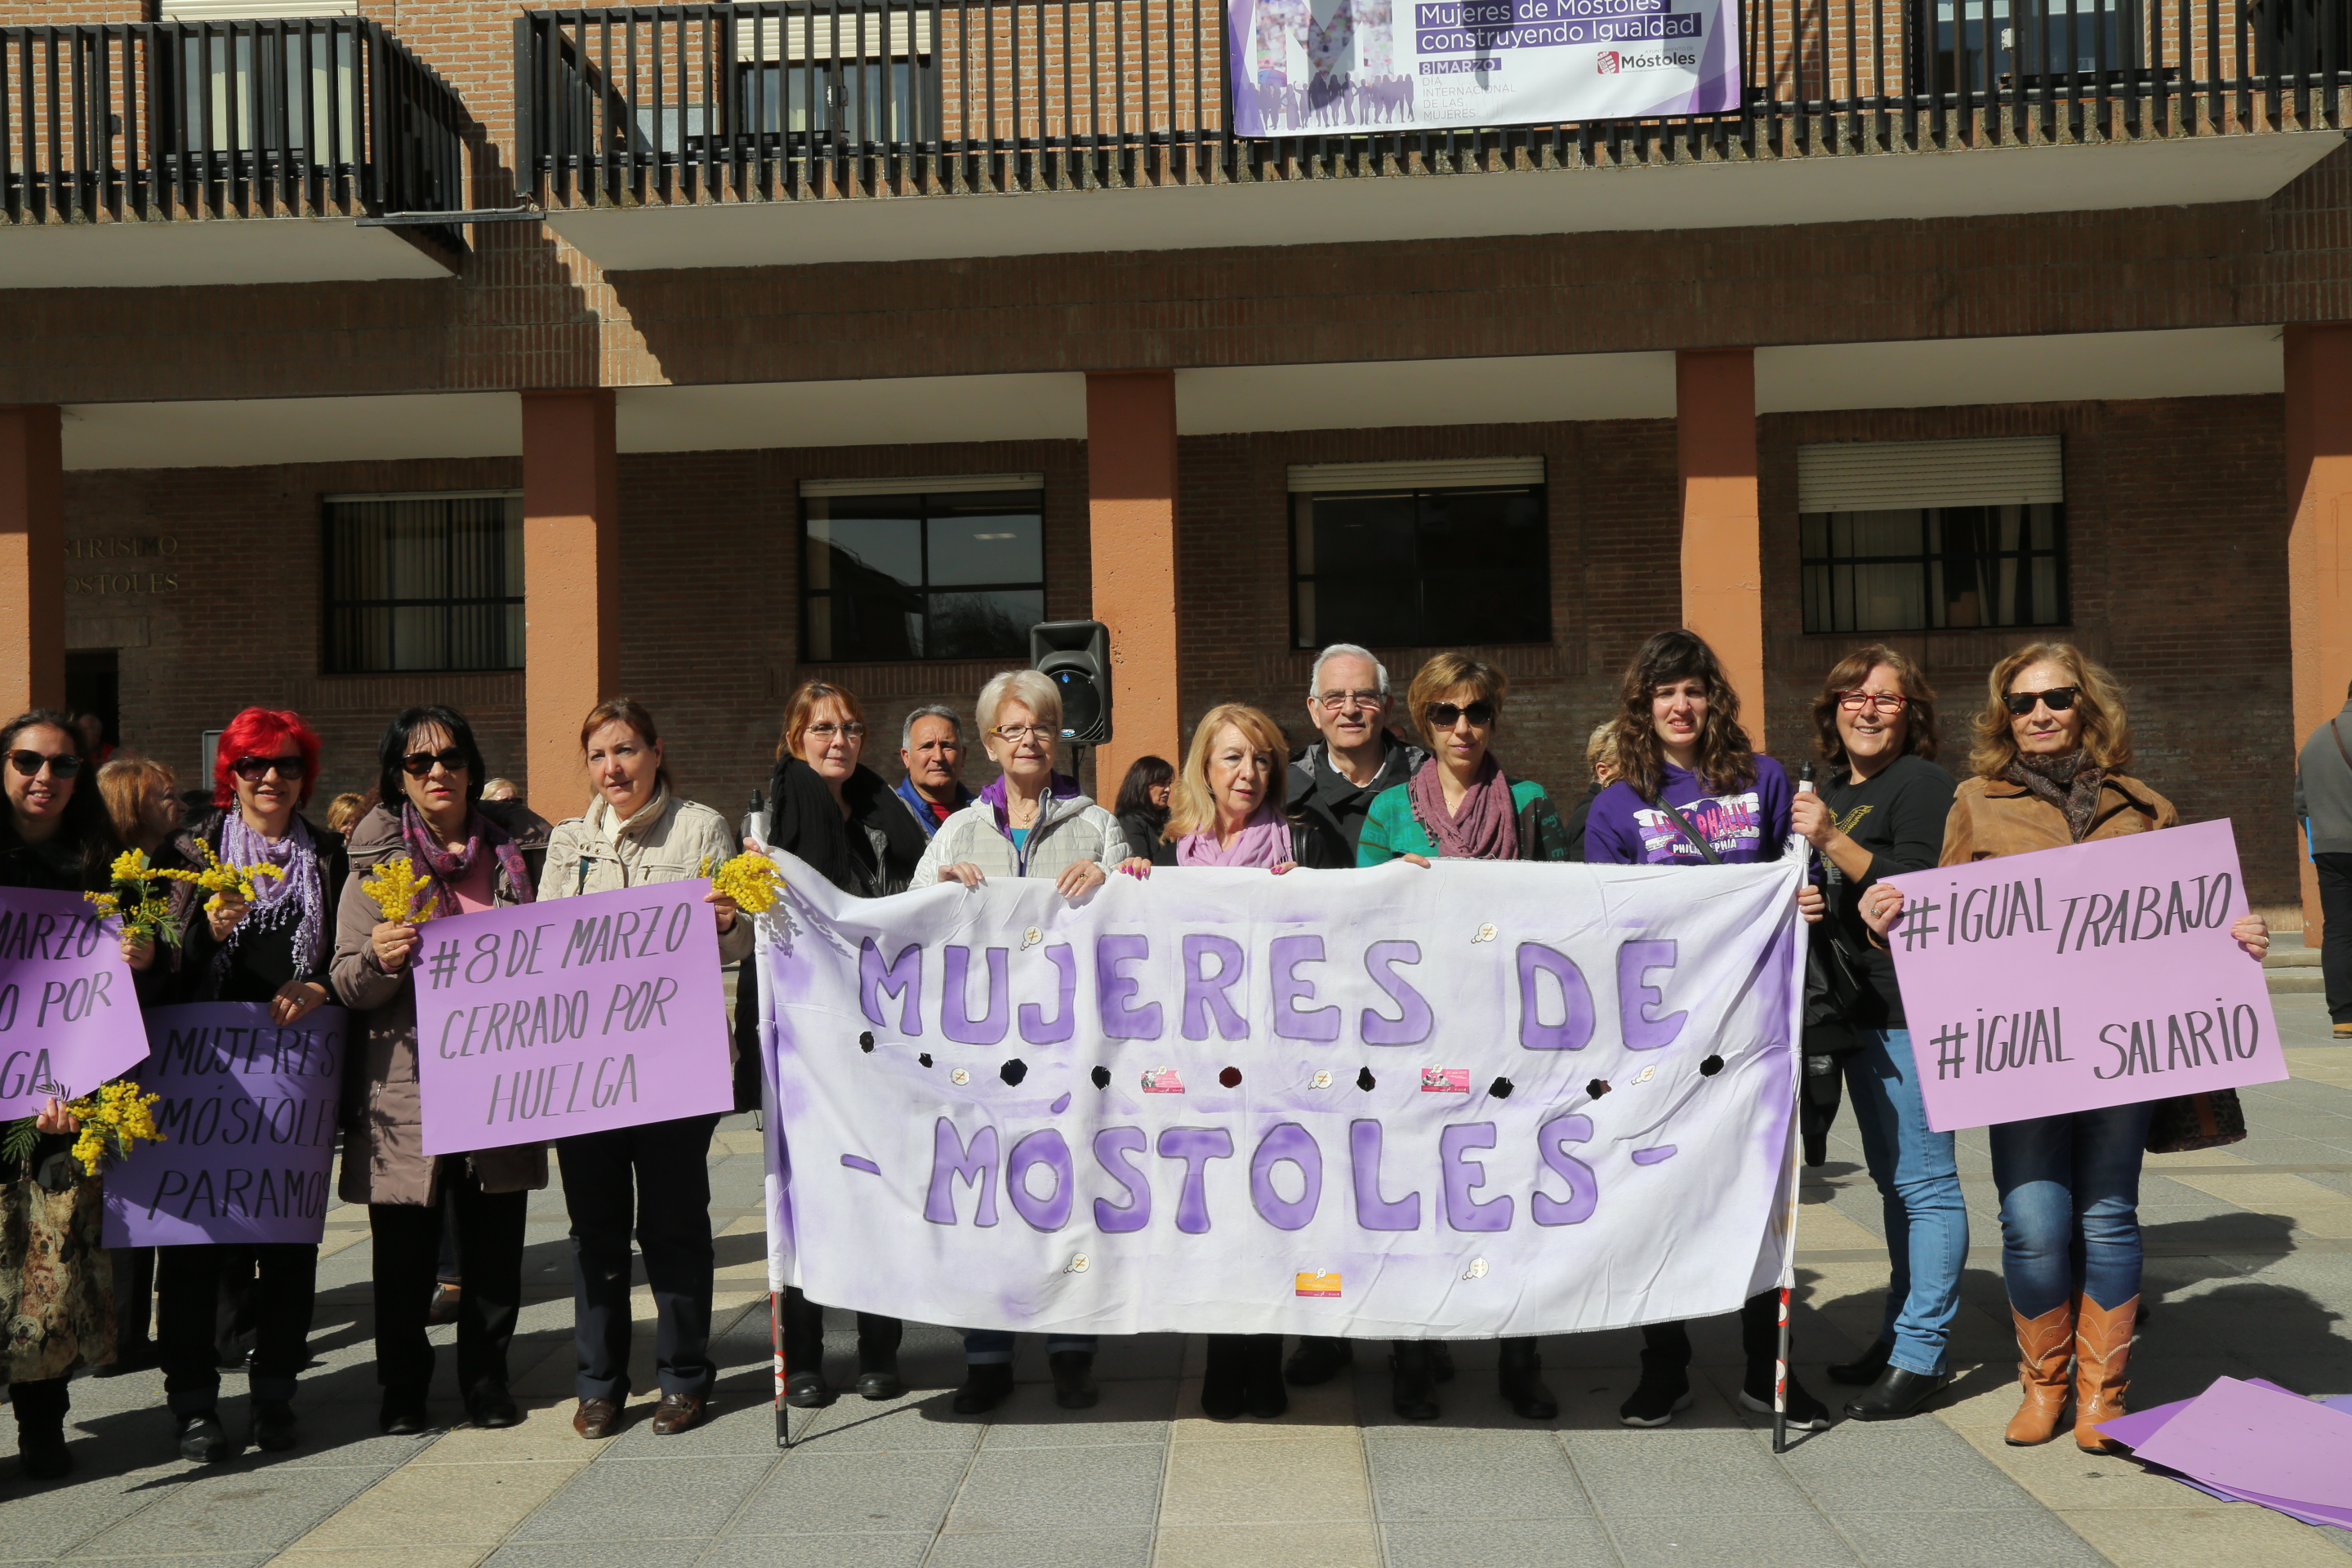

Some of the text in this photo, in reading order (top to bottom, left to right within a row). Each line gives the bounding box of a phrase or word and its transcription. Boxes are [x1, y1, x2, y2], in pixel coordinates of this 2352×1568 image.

[1422, 4, 1511, 27] Mujeres
[1520, 0, 1548, 19] de
[1422, 14, 1695, 50] construyendo Igualdad
[1423, 75, 1442, 86] DÍA
[1622, 52, 1695, 69] Móstoles
[1423, 83, 1517, 97] INTERNACIONAL
[1423, 98, 1463, 108] DE LAS
[1423, 109, 1476, 120] MUJERES
[1696, 801, 1752, 840] PHILLY
[2057, 872, 2232, 954] TRABAJO
[560, 902, 692, 969] MARZO
[38, 971, 113, 1027] POR
[859, 933, 1689, 1052] MUJERES DE
[439, 977, 678, 1059] CERRADO POR
[159, 1027, 338, 1076] MUJERES
[487, 1054, 638, 1125] HUELGA
[923, 1091, 1598, 1234] MÓSTOLES
